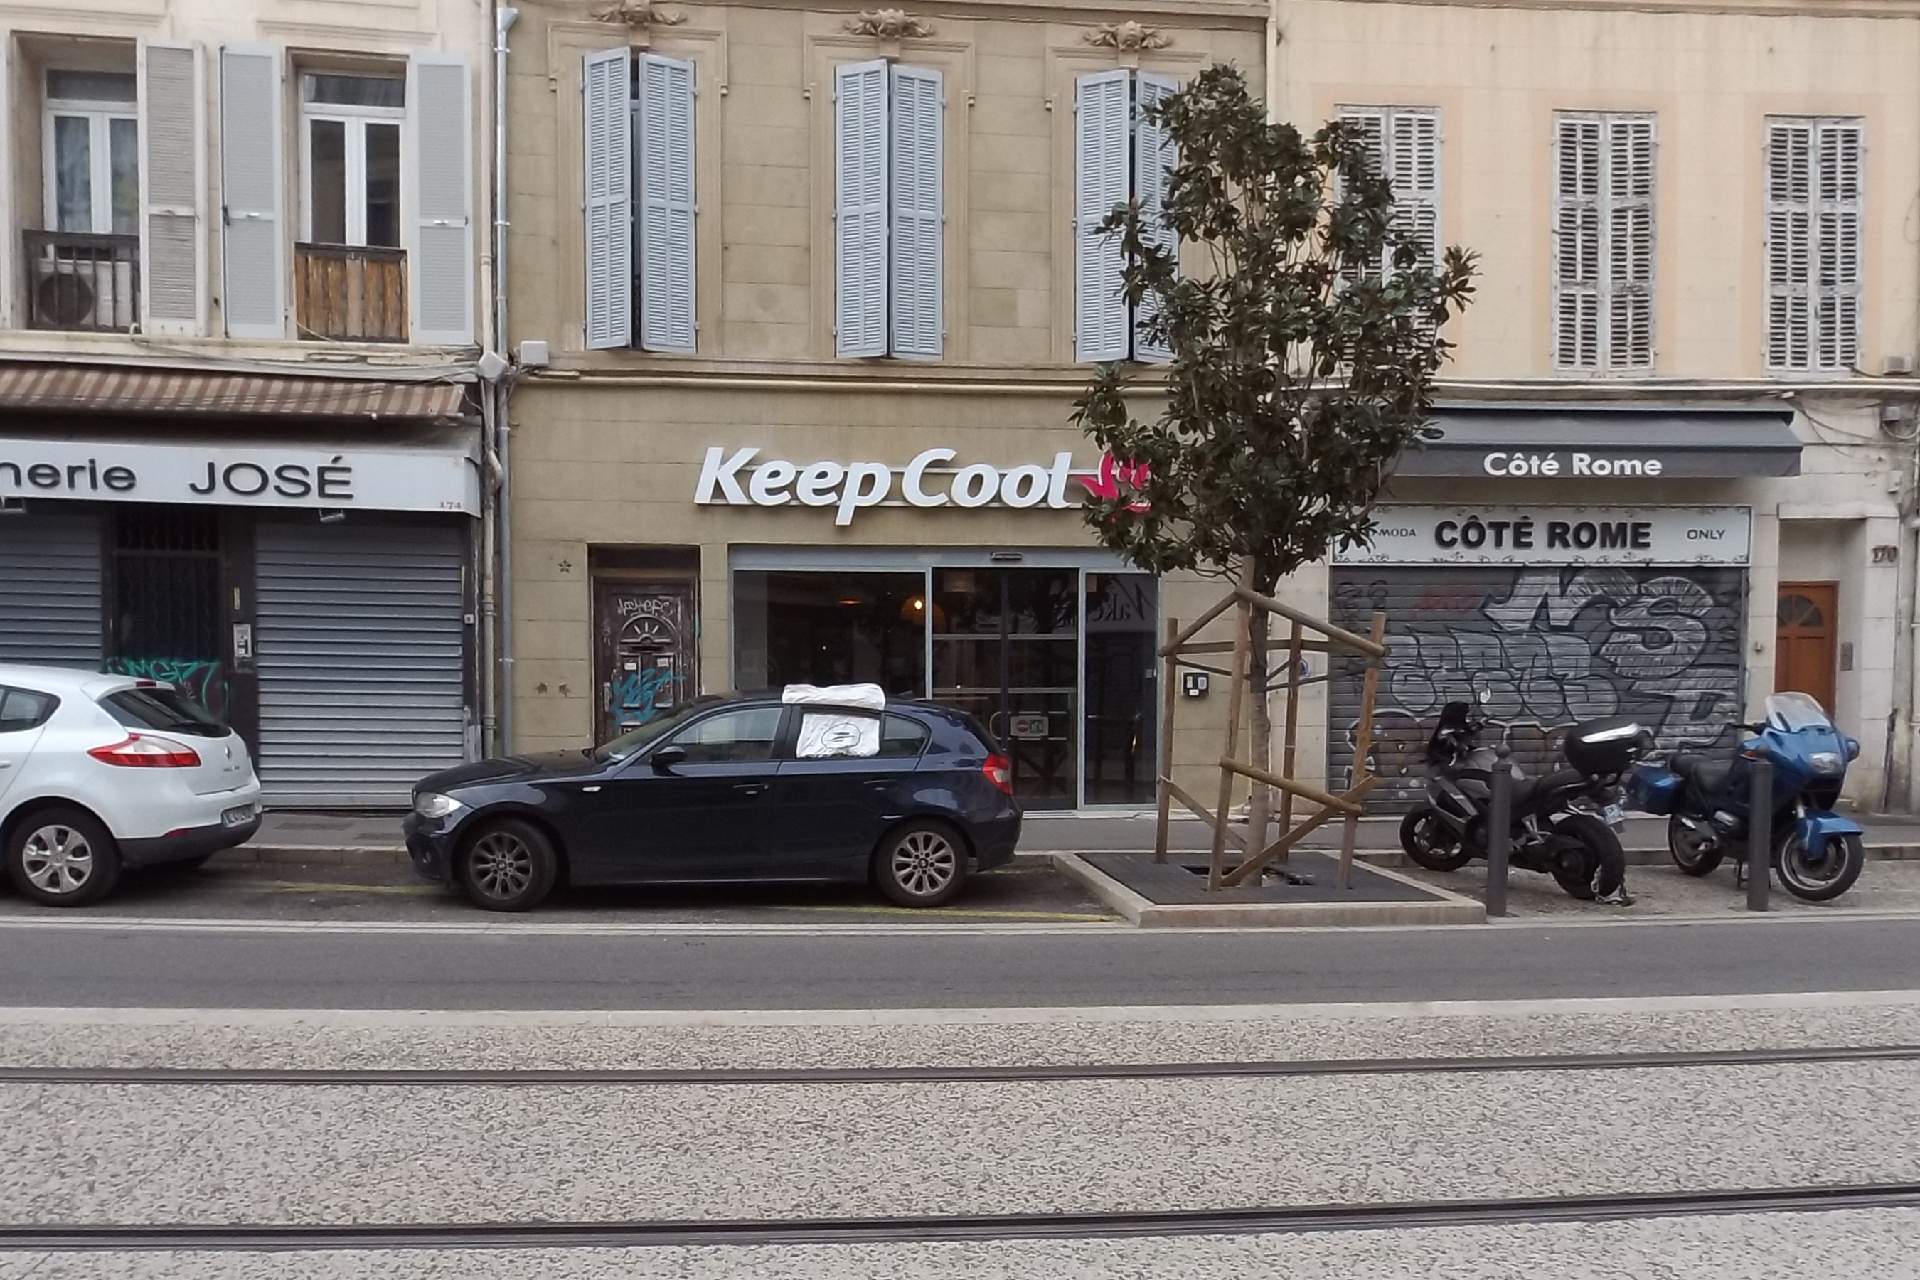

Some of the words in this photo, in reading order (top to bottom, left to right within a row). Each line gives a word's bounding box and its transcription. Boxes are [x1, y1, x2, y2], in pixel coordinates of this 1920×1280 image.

[188, 455, 354, 499] JOSÉ
[1483, 452, 1560, 476] Côté
[1572, 453, 1662, 476] Rome
[694, 447, 891, 526] Keep
[902, 448, 1072, 508] Cool
[1546, 521, 1652, 549] ROME
[1686, 529, 1726, 540] ONLY
